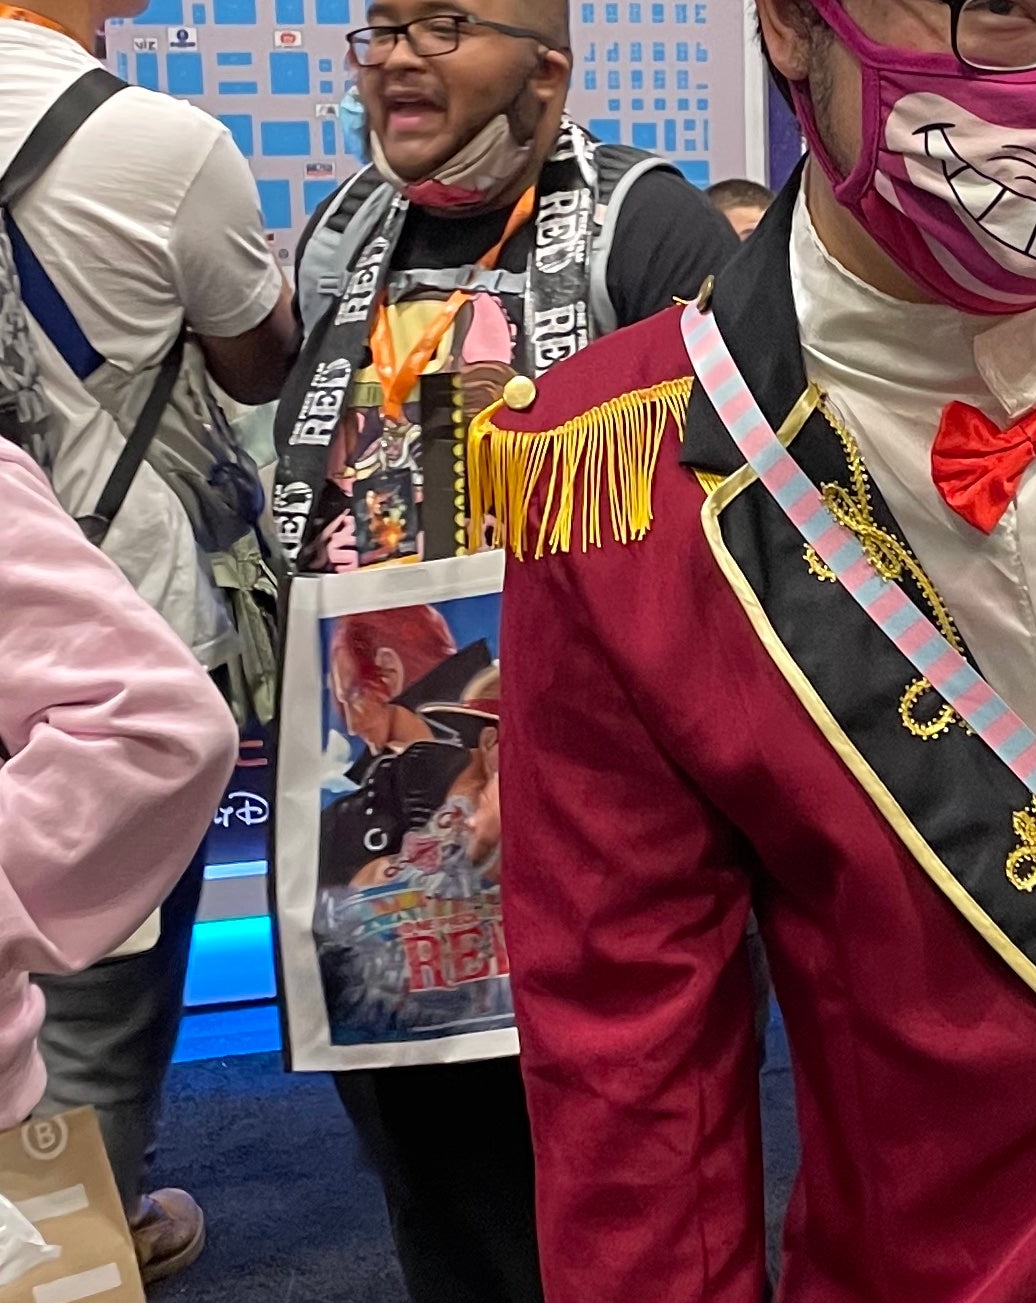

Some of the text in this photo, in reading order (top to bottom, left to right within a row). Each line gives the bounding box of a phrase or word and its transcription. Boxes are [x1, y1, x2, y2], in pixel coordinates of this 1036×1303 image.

[535, 189, 581, 274] RED
[335, 235, 390, 326] RED
[533, 303, 577, 379] RE
[296, 357, 352, 446] RED
